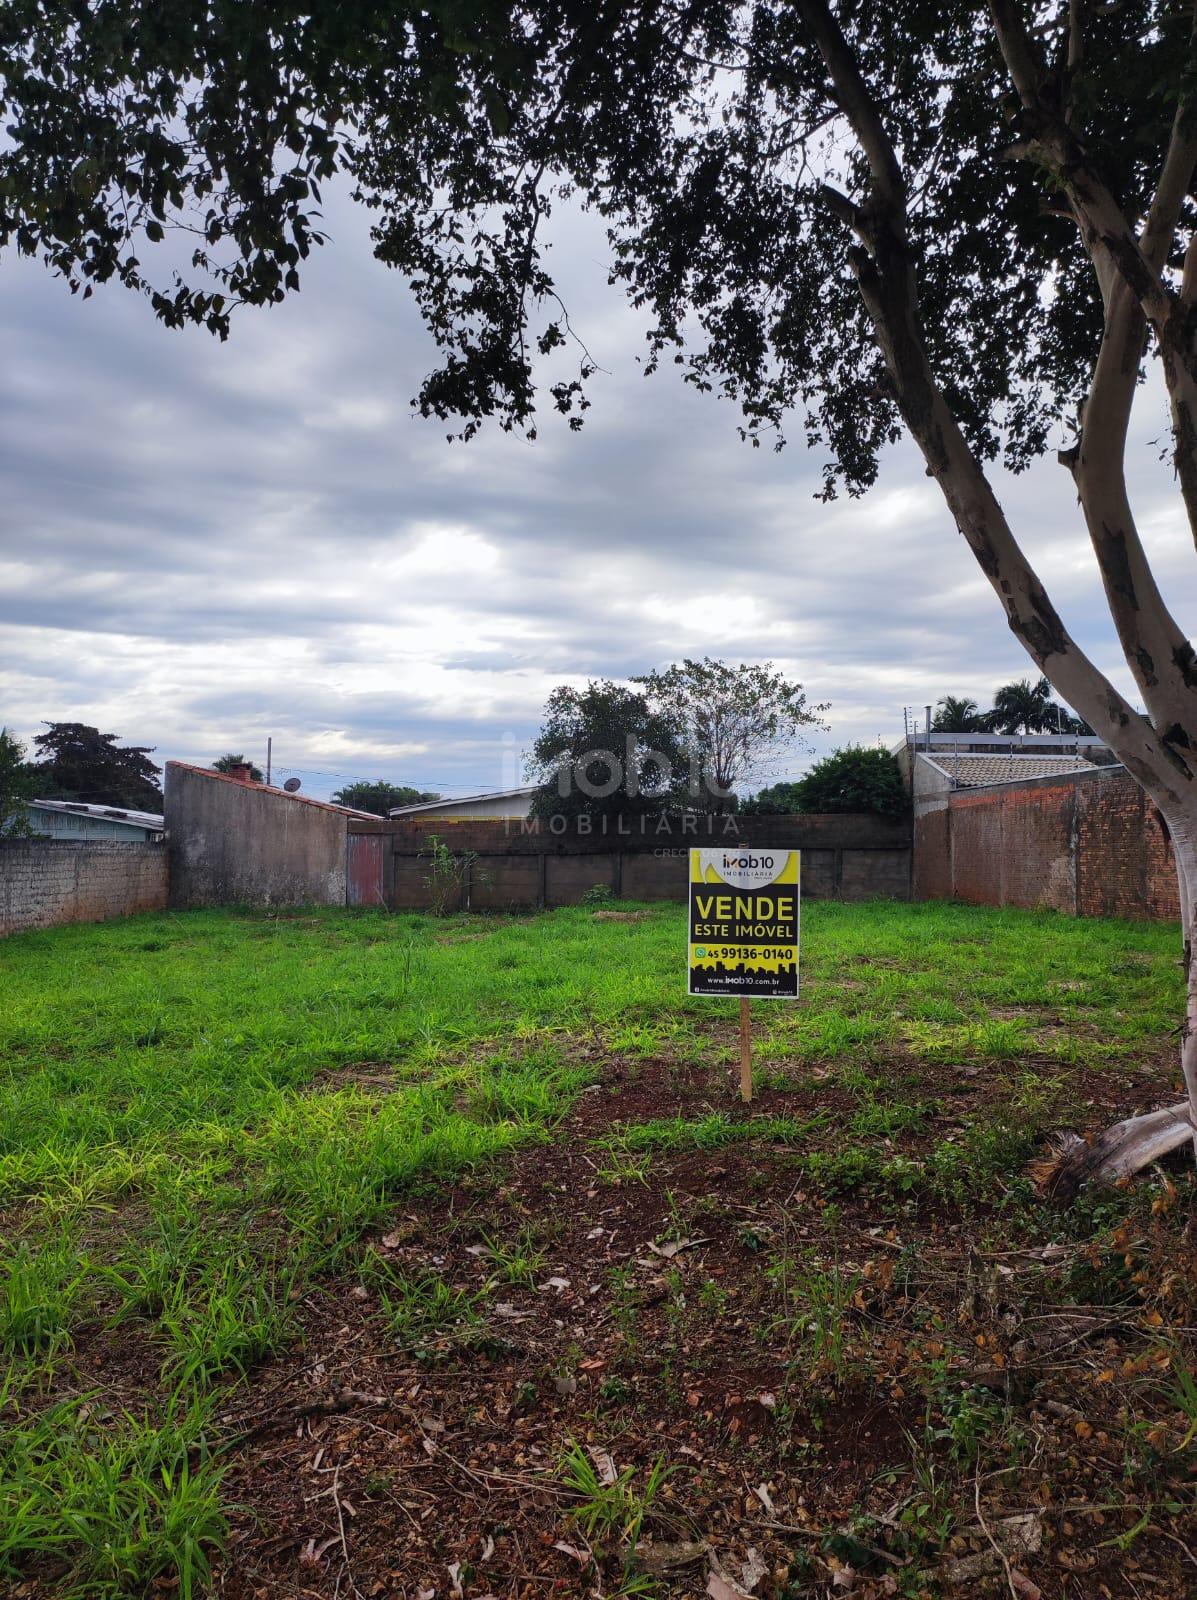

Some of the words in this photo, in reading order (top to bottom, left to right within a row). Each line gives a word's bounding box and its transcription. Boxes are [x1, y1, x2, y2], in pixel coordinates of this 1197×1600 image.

[695, 896, 794, 921] VENDE
[694, 924, 729, 937] ESTE
[735, 923, 793, 938] IMÓVEL
[707, 950, 719, 959] 45
[721, 947, 793, 960] 99136-0140
